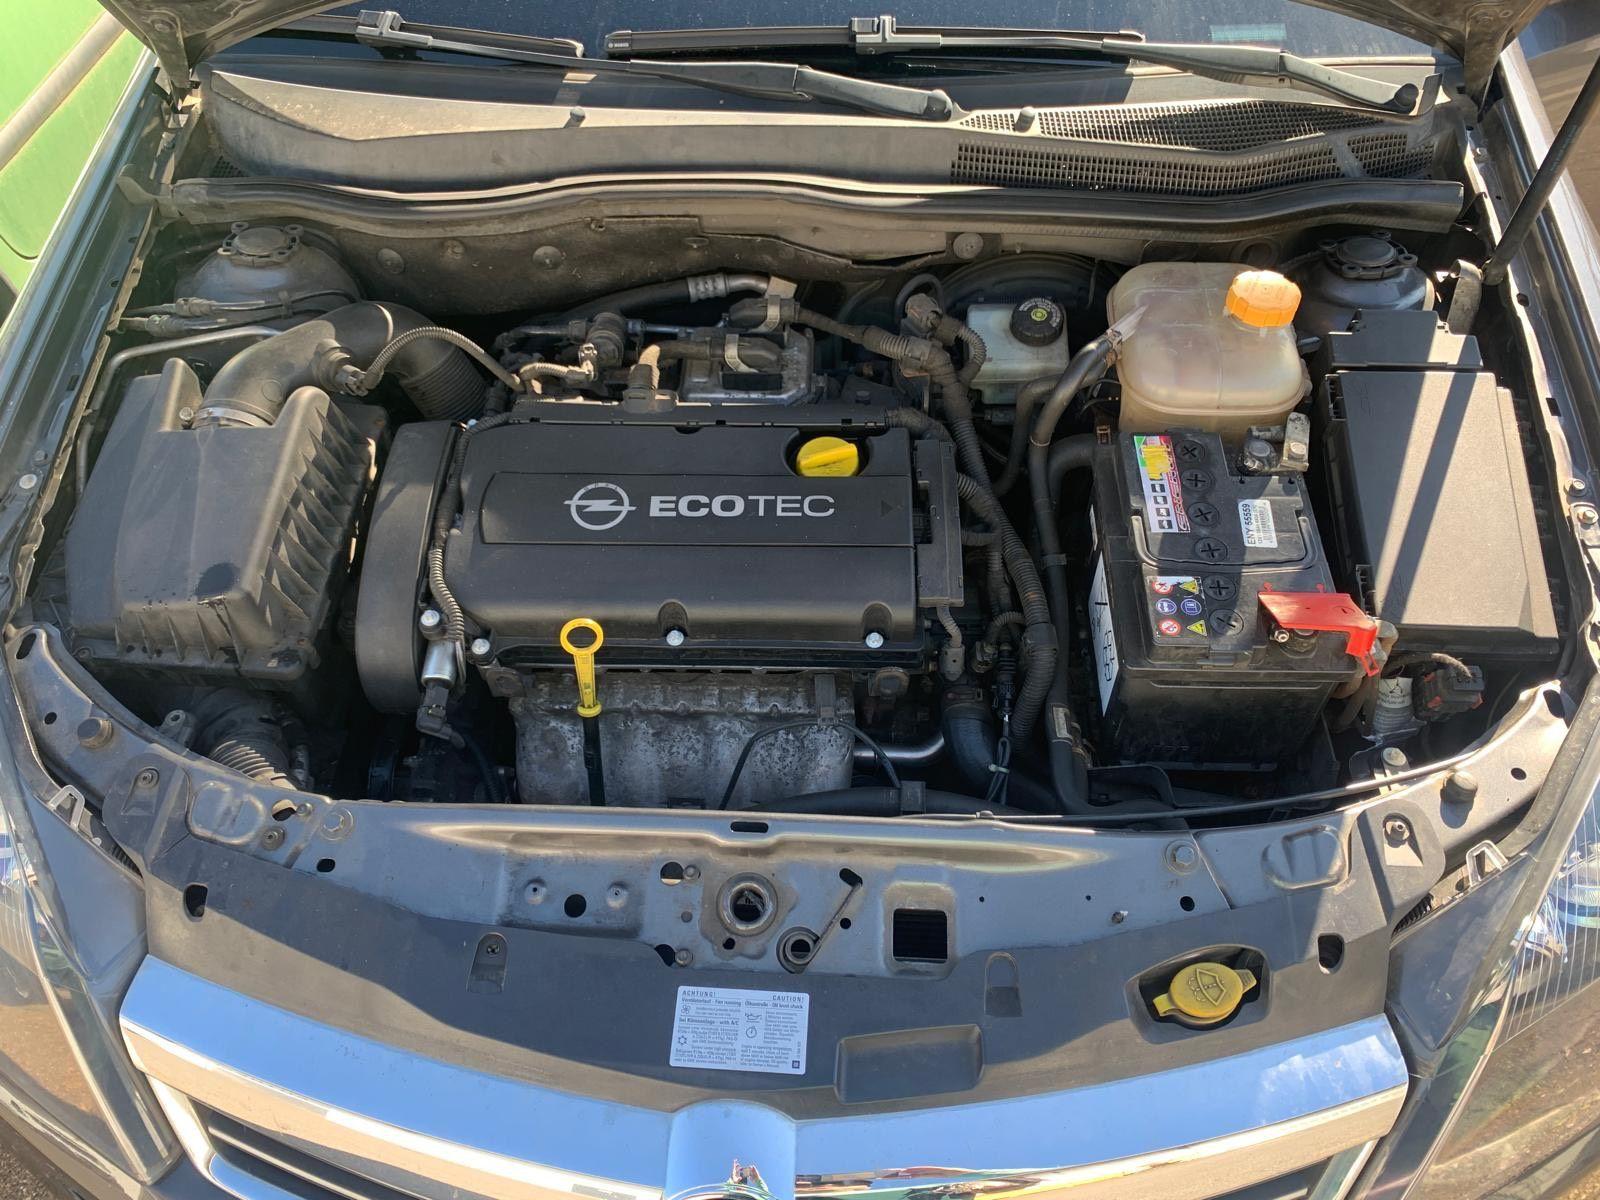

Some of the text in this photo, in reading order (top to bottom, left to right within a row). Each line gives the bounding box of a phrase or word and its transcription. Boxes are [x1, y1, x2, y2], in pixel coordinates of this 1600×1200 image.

[649, 494, 835, 518] ECOTEC
[1242, 503, 1256, 545] ENY 55559
[682, 990, 716, 998] ACHTUNG!
[772, 995, 805, 1003] CAUTION!
